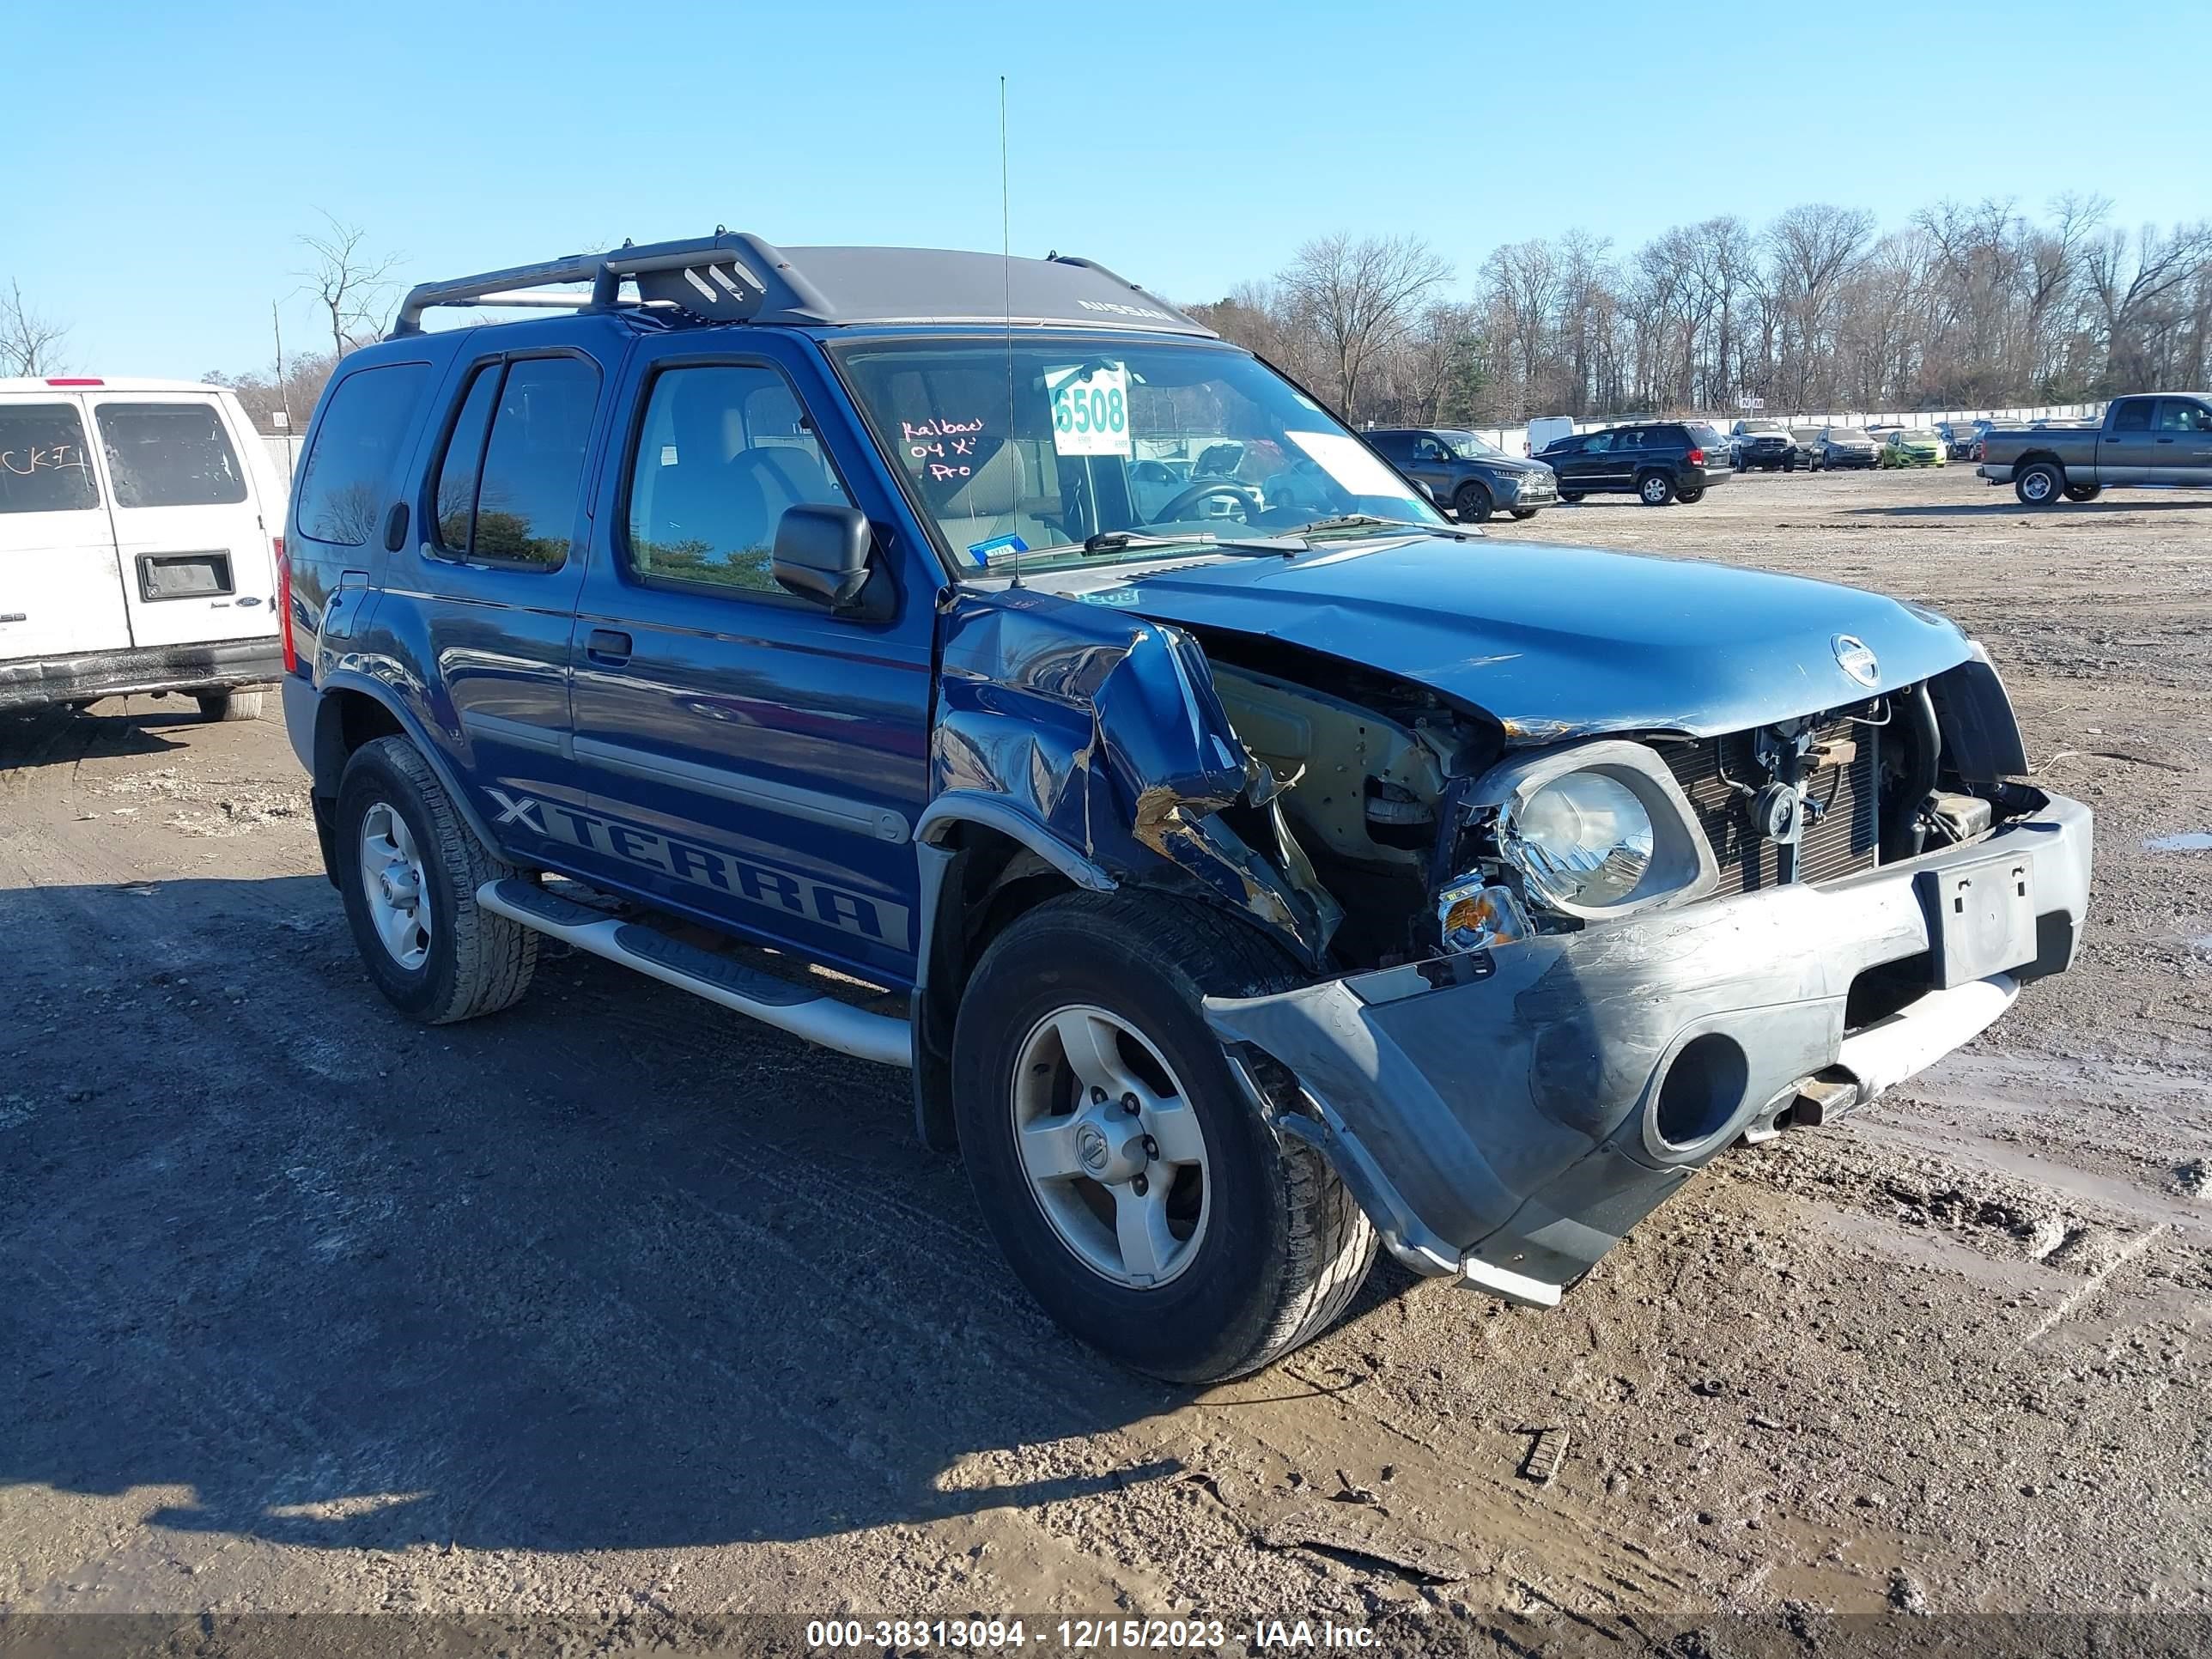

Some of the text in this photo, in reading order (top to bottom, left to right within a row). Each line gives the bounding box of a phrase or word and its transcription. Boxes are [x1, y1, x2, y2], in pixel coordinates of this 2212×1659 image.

[1077, 301, 1176, 322] NISSAN
[1054, 388, 1124, 433] 6508
[929, 464, 970, 481] Pro
